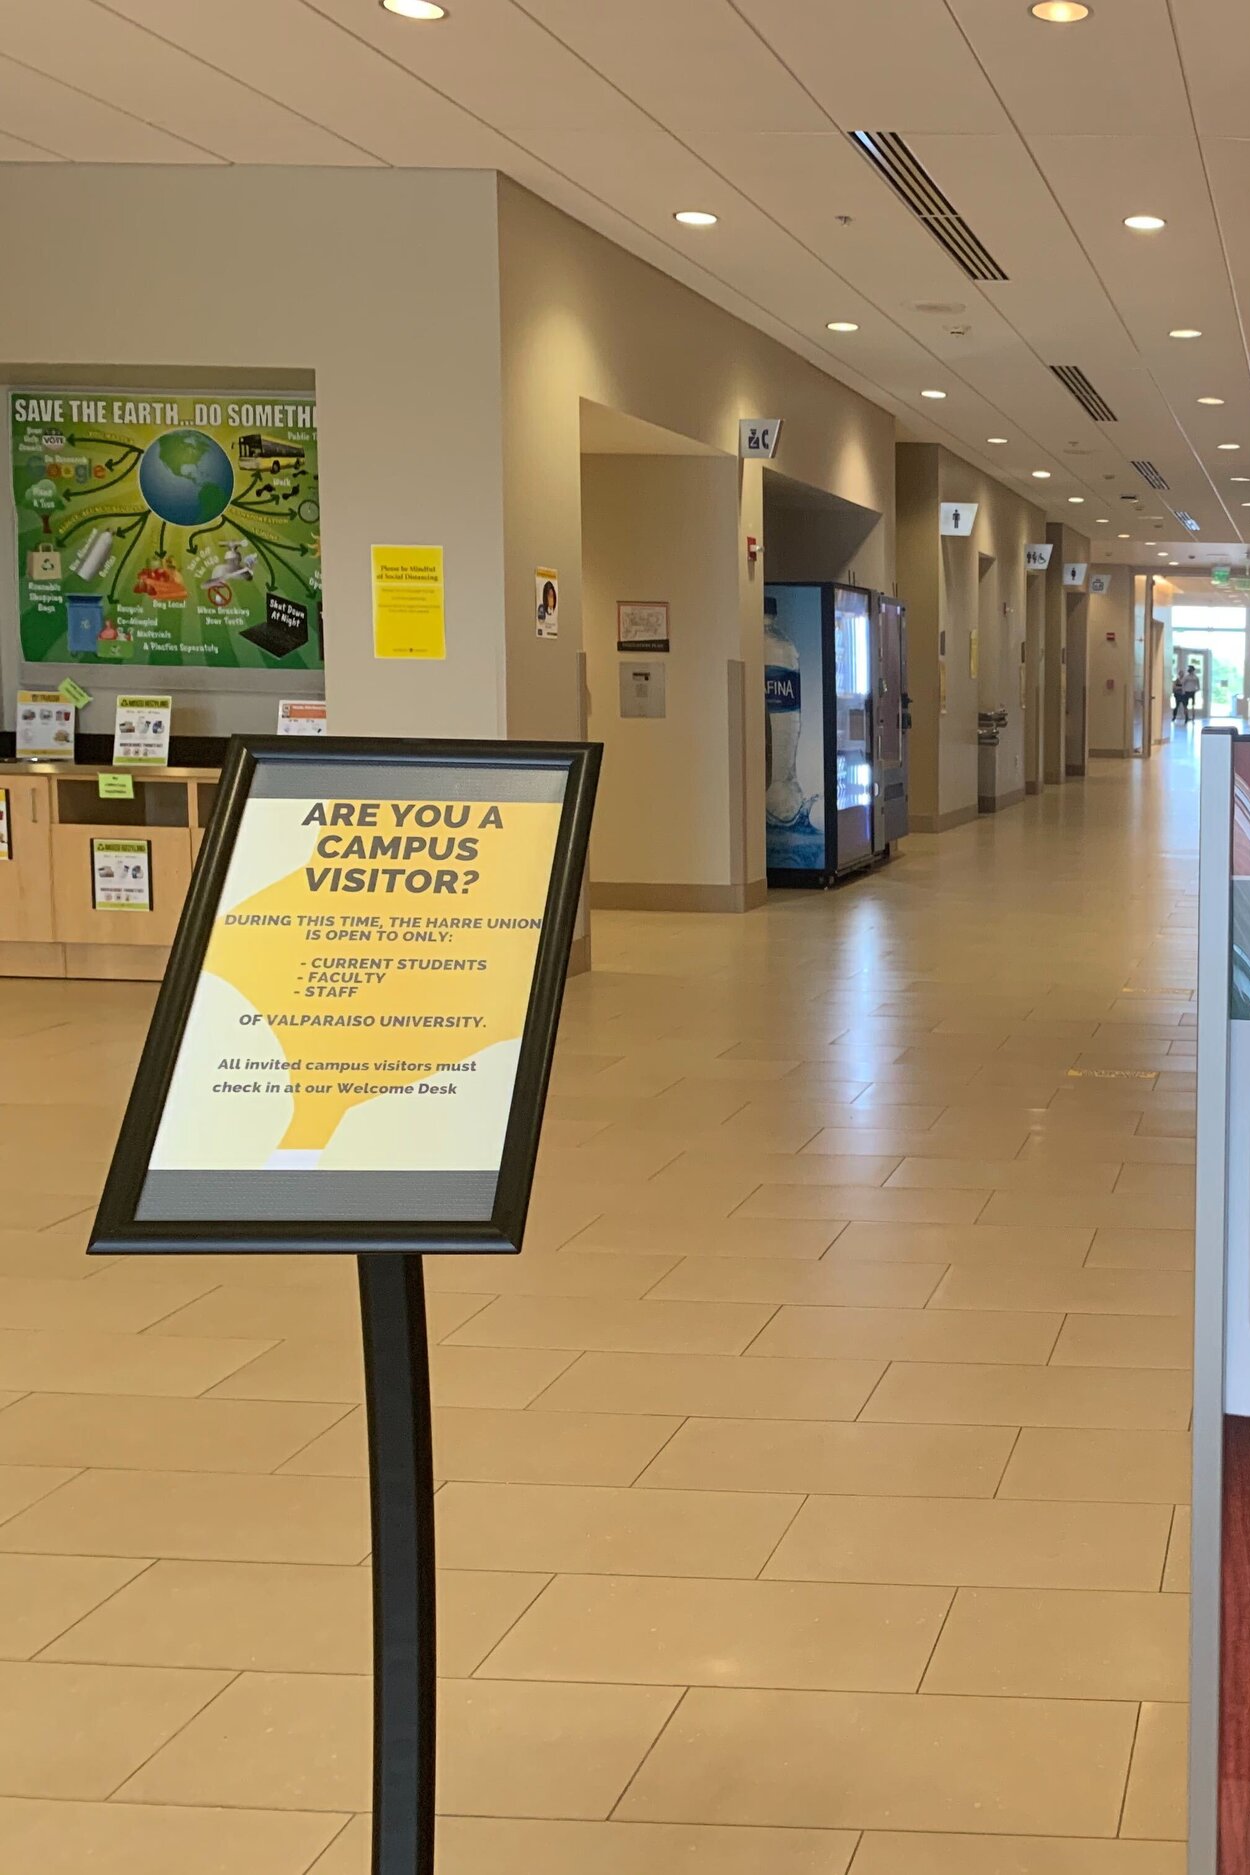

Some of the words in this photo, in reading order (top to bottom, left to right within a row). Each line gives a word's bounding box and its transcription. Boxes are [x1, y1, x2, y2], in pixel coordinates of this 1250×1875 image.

[15, 399, 64, 422] SAVE
[69, 400, 107, 423] THE
[269, 599, 286, 612] Shut
[287, 605, 305, 620] Down
[271, 611, 280, 620] At
[281, 612, 301, 628] Night
[765, 679, 795, 699] FINA
[301, 802, 379, 828] ARE
[391, 803, 471, 829] YOU
[477, 805, 504, 829] A
[316, 834, 480, 862] CAMPUS
[305, 867, 481, 895] VISITOR?
[224, 914, 292, 928] DURING
[297, 915, 336, 928] THIS
[339, 916, 385, 930] TIME,
[388, 917, 423, 929] THE
[425, 917, 483, 929] HARRE
[486, 918, 542, 930] UNION
[305, 929, 322, 941] IS
[325, 930, 372, 942] OPEN
[376, 930, 399, 942] TO
[402, 931, 454, 943] ONLY:
[311, 958, 393, 970] CURRENT
[397, 958, 488, 972] STUDENTS
[307, 972, 387, 984] FACULTY
[304, 986, 359, 998] STAFF
[238, 1014, 263, 1026] OF
[267, 1014, 377, 1028] VALPARAISO
[379, 1015, 487, 1029] UNIVERSITY.
[217, 1058, 241, 1071] All
[244, 1058, 302, 1072] invited
[305, 1060, 370, 1075] campus
[373, 1059, 432, 1073] visitors
[435, 1060, 477, 1073] must
[212, 1081, 262, 1094] check
[264, 1081, 281, 1094] in
[284, 1082, 302, 1094] at
[305, 1084, 332, 1095] our
[337, 1082, 414, 1096] Welcome
[418, 1082, 458, 1096] Desk
